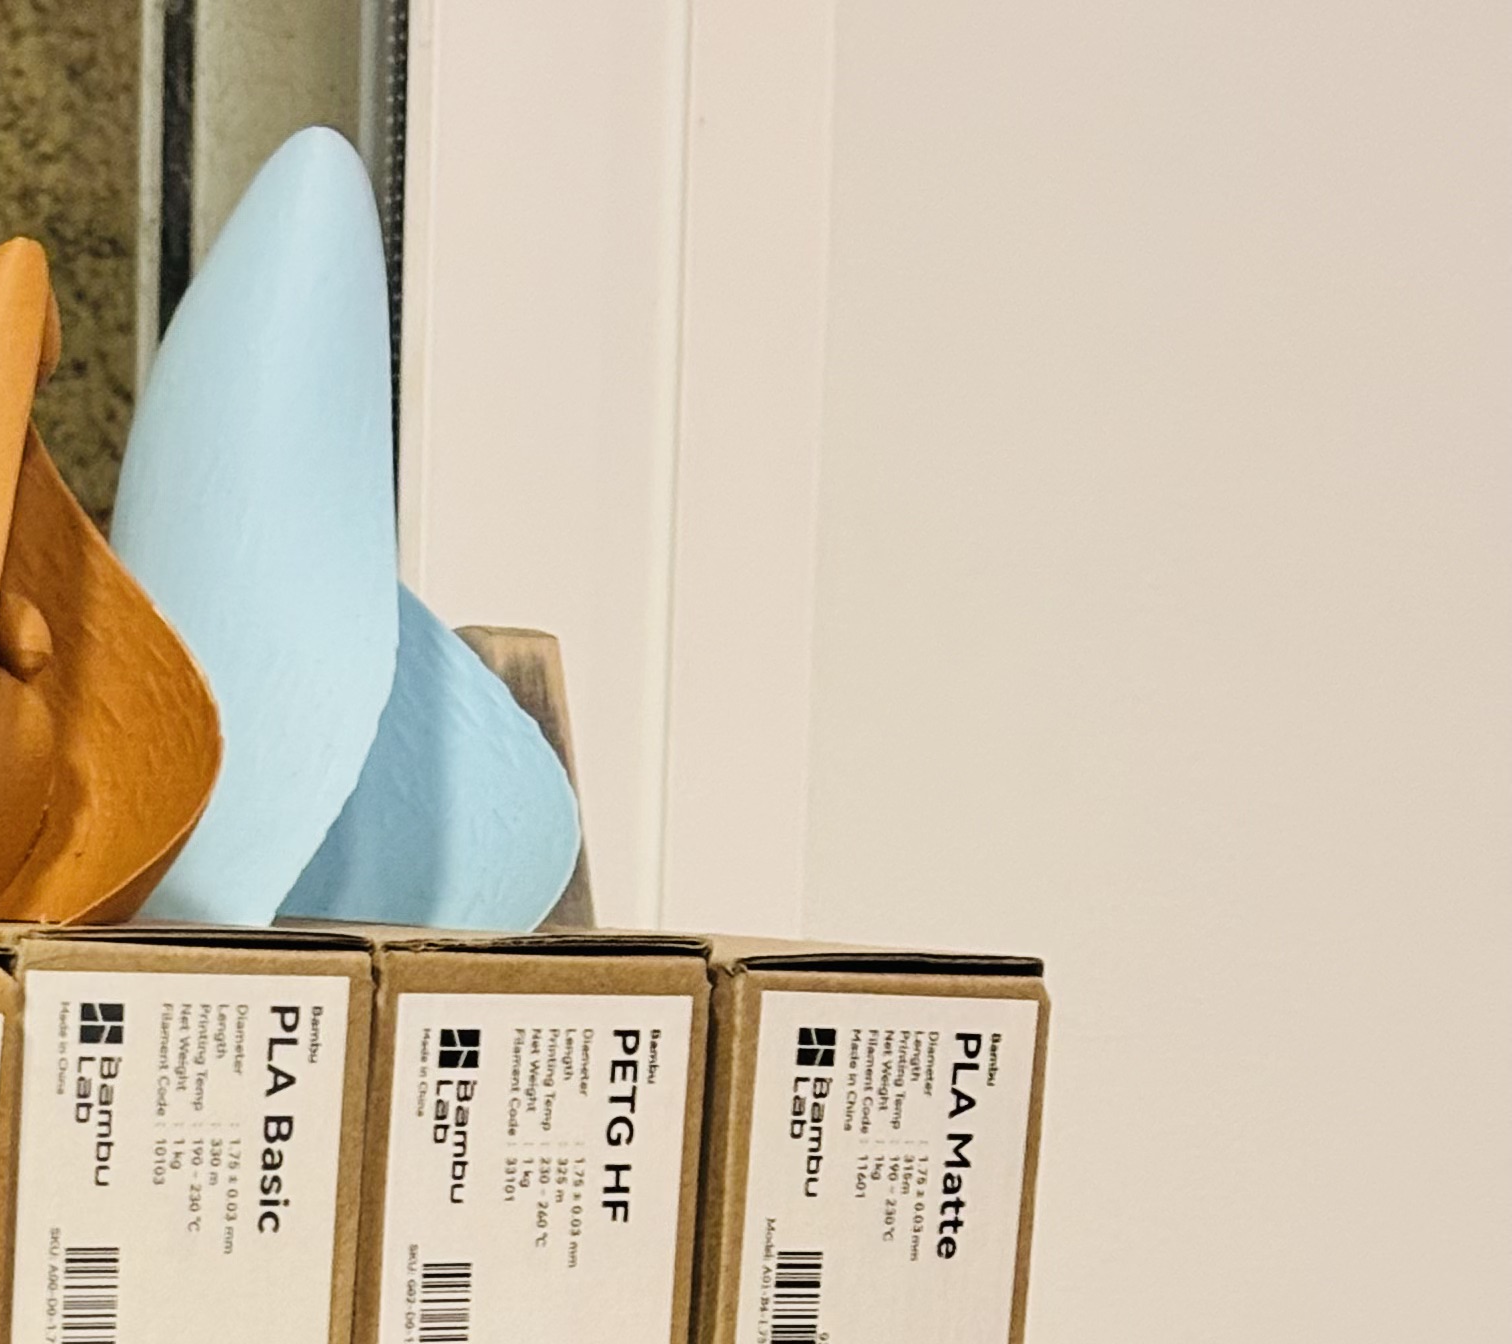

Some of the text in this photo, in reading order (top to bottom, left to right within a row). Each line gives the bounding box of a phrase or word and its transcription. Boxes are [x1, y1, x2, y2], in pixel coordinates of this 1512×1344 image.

[178, 1003, 192, 1030] Net
[192, 1003, 211, 1065] Printing
[307, 1005, 323, 1063] Bambu
[530, 1028, 541, 1054] Net
[882, 1029, 894, 1055] Net
[173, 1036, 190, 1091] Weight
[542, 1028, 560, 1087] Printing
[647, 1029, 661, 1084] Bambu
[892, 1030, 910, 1087] Printing
[909, 1030, 924, 1081] Length
[986, 1033, 1001, 1086] Bambu
[74, 1056, 95, 1123] Lab
[152, 1002, 173, 1185] Filament Code 10103
[190, 1069, 207, 1111] Temp
[208, 1003, 229, 1186] Length 330 m
[432, 1079, 453, 1143] Lab
[524, 1059, 539, 1111] Weight
[539, 1092, 555, 1131] Temp
[789, 1076, 810, 1139] Lab
[876, 1060, 892, 1110] Weight
[889, 1091, 905, 1129] Temp
[94, 1056, 121, 1186] Bambu
[257, 1005, 300, 1233] PLA Basic
[449, 1079, 477, 1203] Bambu
[503, 1028, 525, 1201] Filament Code 33101
[555, 1028, 576, 1203] Length 325 m
[601, 1029, 640, 1222] PETG HF
[804, 1076, 832, 1197] Bambu
[854, 1029, 879, 1198] Filament Code 11601
[168, 1151, 184, 1169] kg
[190, 1138, 203, 1166] 190
[538, 1157, 551, 1184] 230
[887, 1156, 900, 1181] 190
[936, 1032, 982, 1259] PLA Matte
[188, 1184, 201, 1212] 230
[518, 1170, 532, 1187] kg
[535, 1201, 548, 1228] 260
